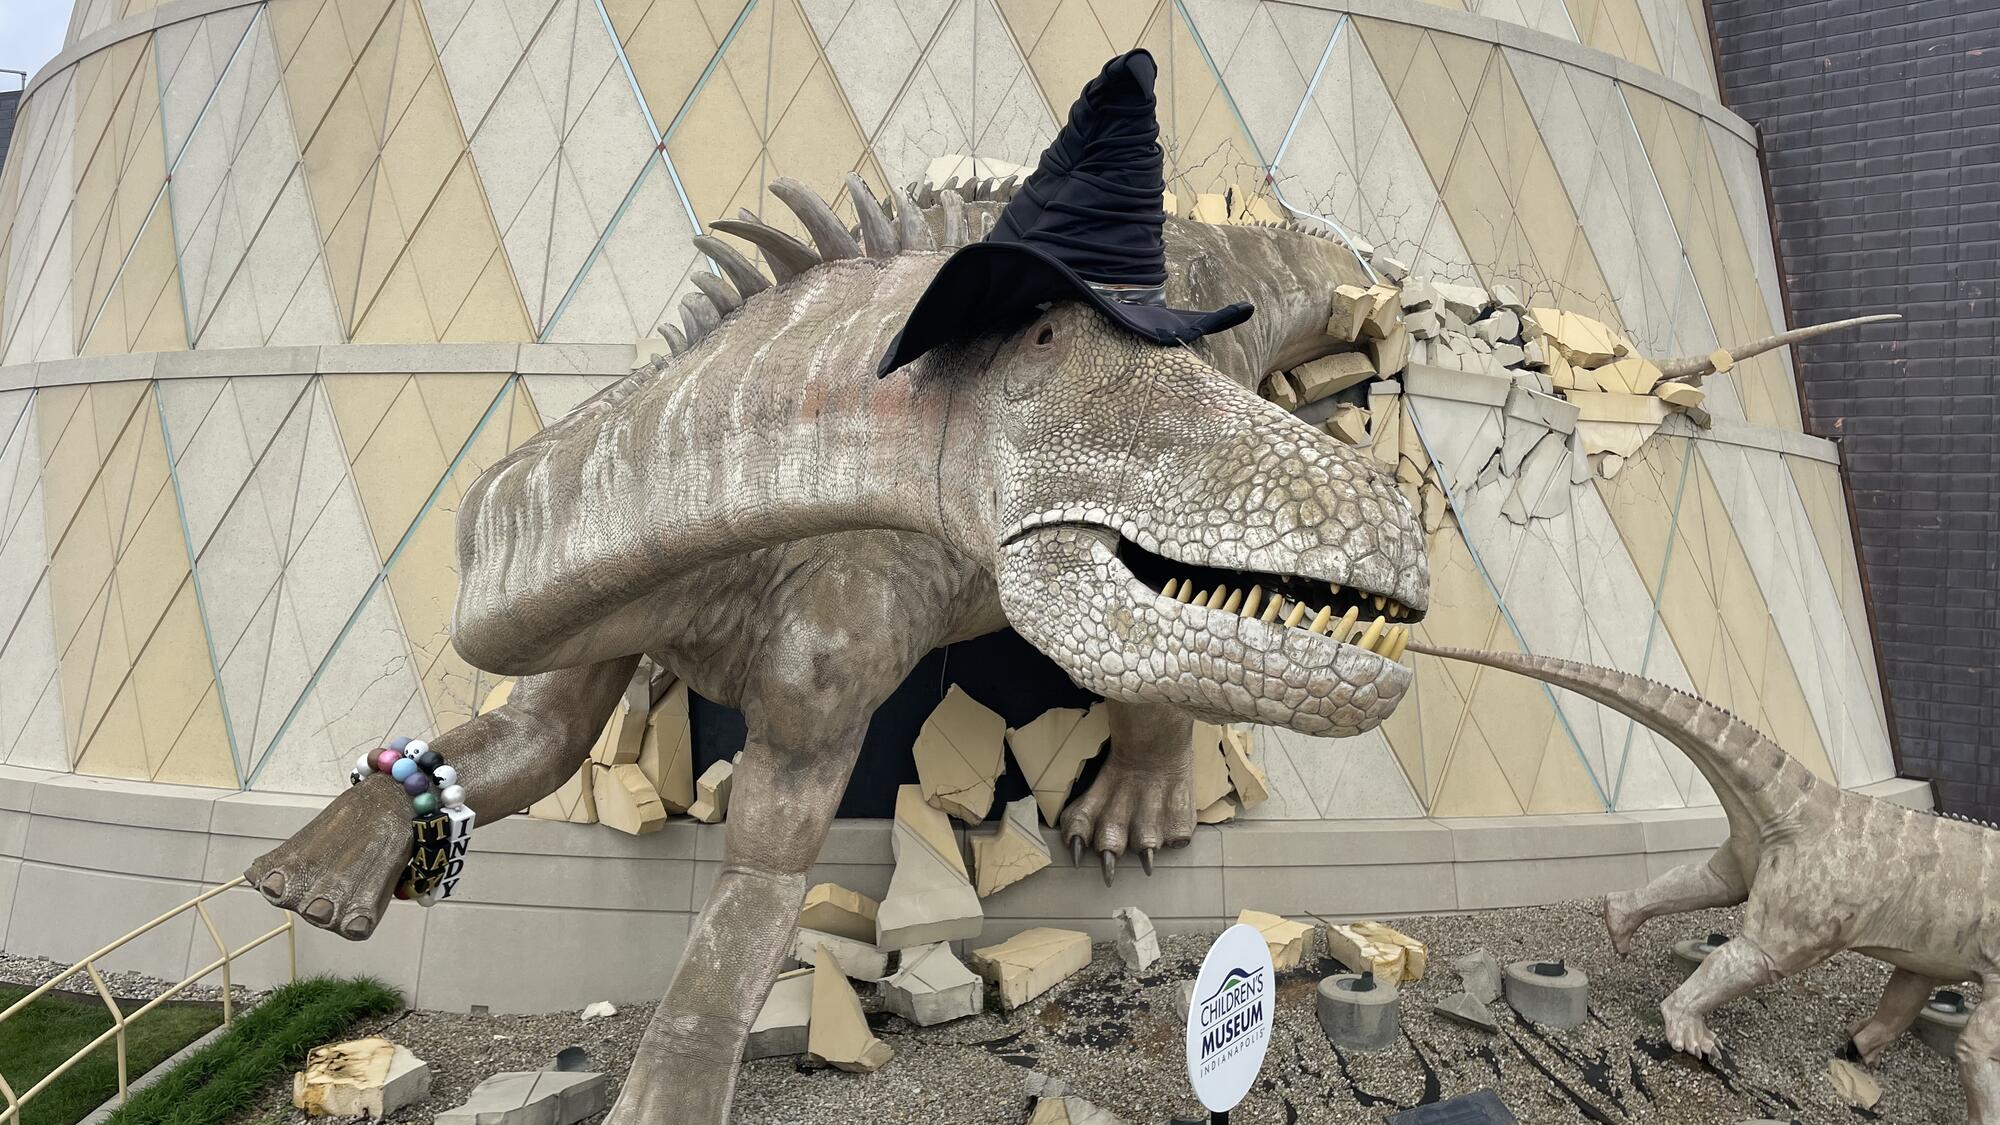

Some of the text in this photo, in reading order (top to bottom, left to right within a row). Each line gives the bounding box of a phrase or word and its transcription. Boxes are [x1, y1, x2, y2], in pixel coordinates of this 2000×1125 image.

[441, 817, 471, 899] INDY
[1201, 974, 1264, 1027] CHILDREN'S
[1200, 1030, 1264, 1078] INDIANAPOLIS
[1201, 1000, 1263, 1060] MUSEUM
